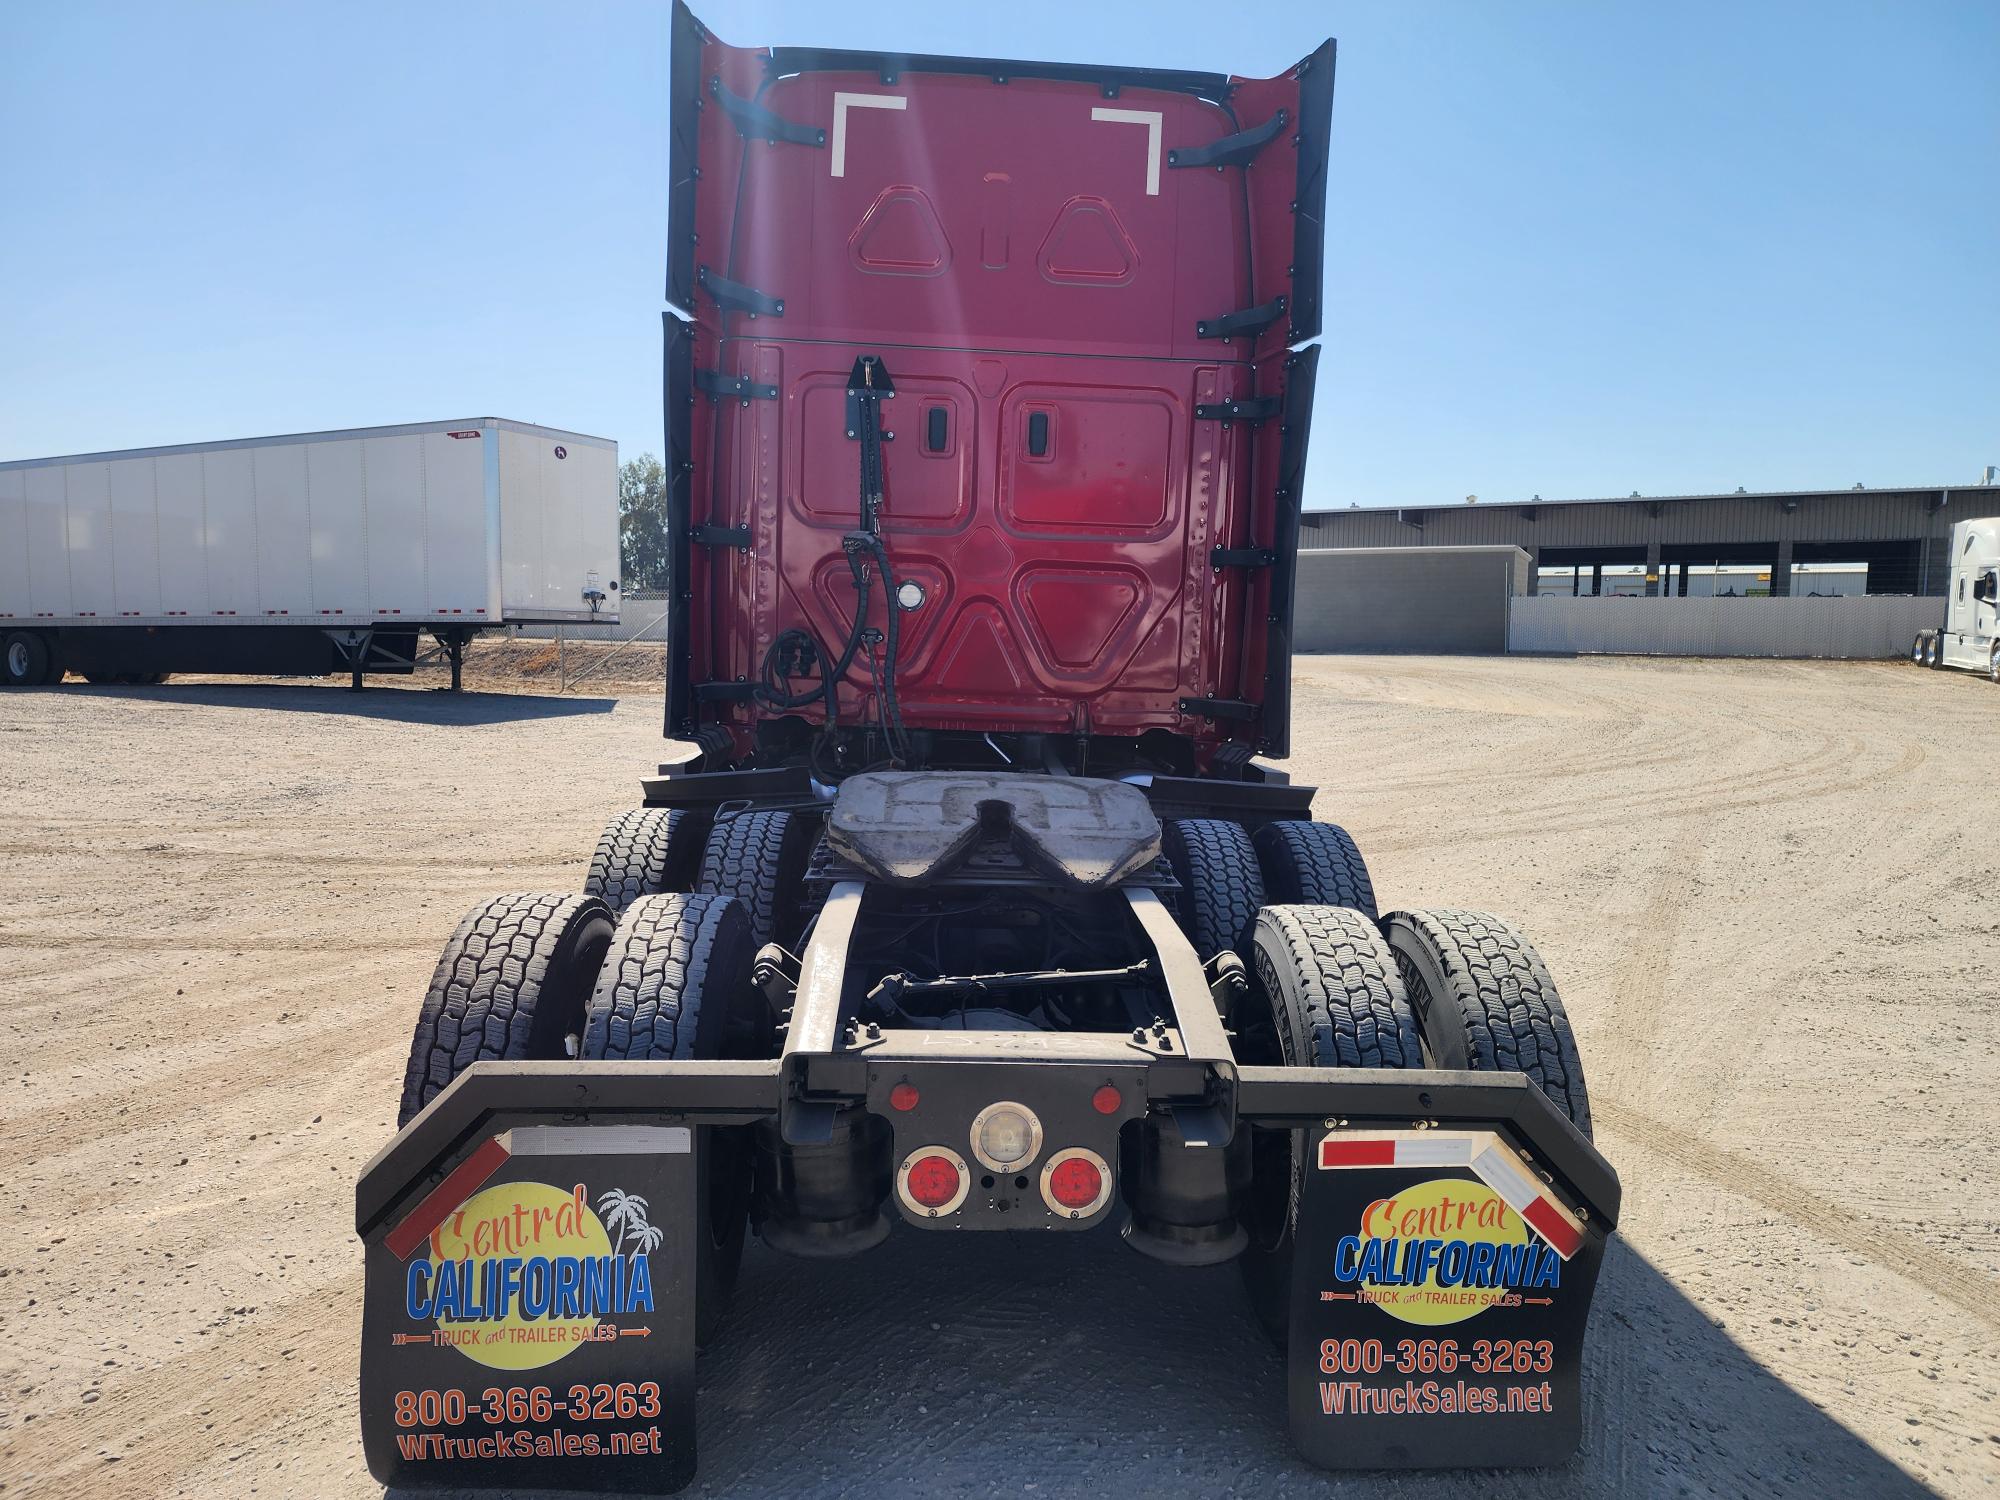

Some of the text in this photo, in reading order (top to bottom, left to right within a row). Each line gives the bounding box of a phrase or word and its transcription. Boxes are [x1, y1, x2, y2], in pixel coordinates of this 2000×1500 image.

[430, 1183, 589, 1264] Central
[1334, 1235, 1560, 1288] CALIFORNIA
[406, 1253, 655, 1322] CALIFORNIA
[1355, 1290, 1522, 1307] TRUCK and TRAILER SALES
[432, 1324, 617, 1346] TRUCK and TRAILER SALES
[1319, 1338, 1554, 1374] 800-366-3263
[394, 1381, 662, 1427] 800-366-3263
[1319, 1381, 1553, 1415] WTruckSales.net
[396, 1426, 662, 1461] WTruckSales.net
